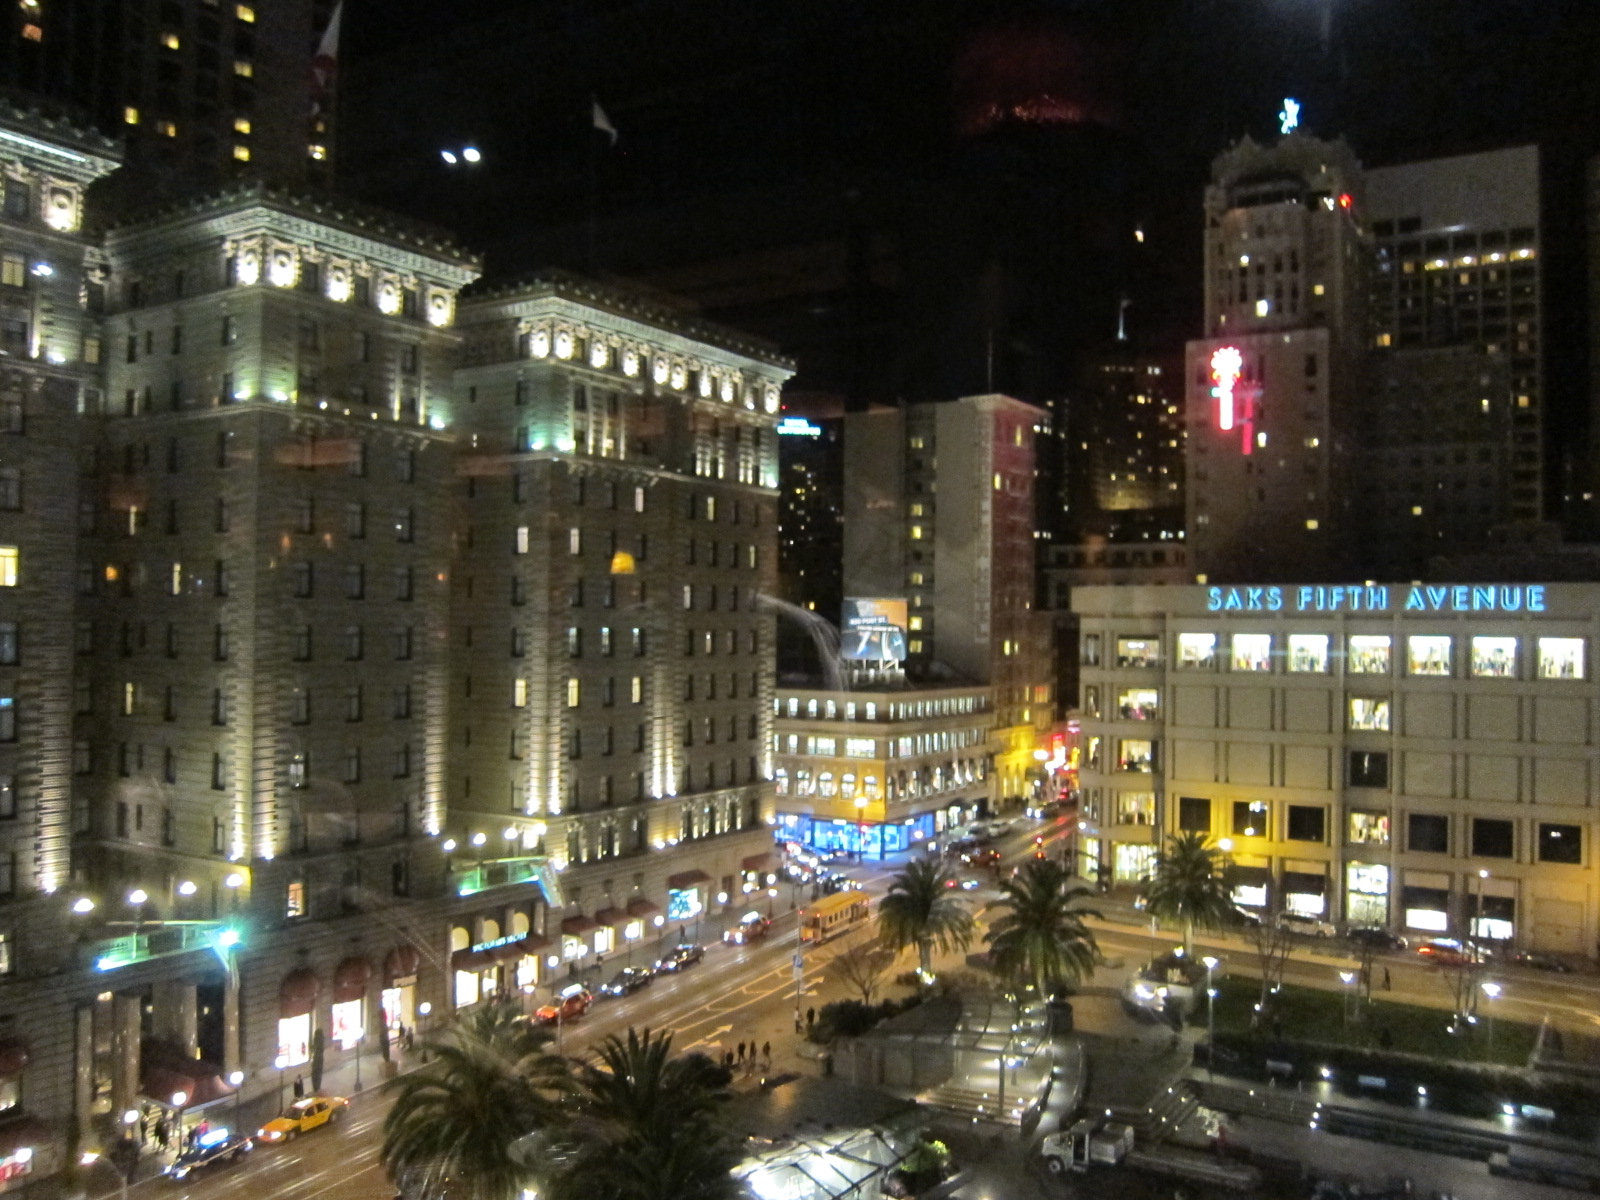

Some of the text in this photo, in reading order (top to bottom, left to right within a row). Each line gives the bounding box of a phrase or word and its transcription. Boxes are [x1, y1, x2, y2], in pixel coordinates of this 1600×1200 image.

[1207, 585, 1545, 611] SAKS FIFTH AVENUE
